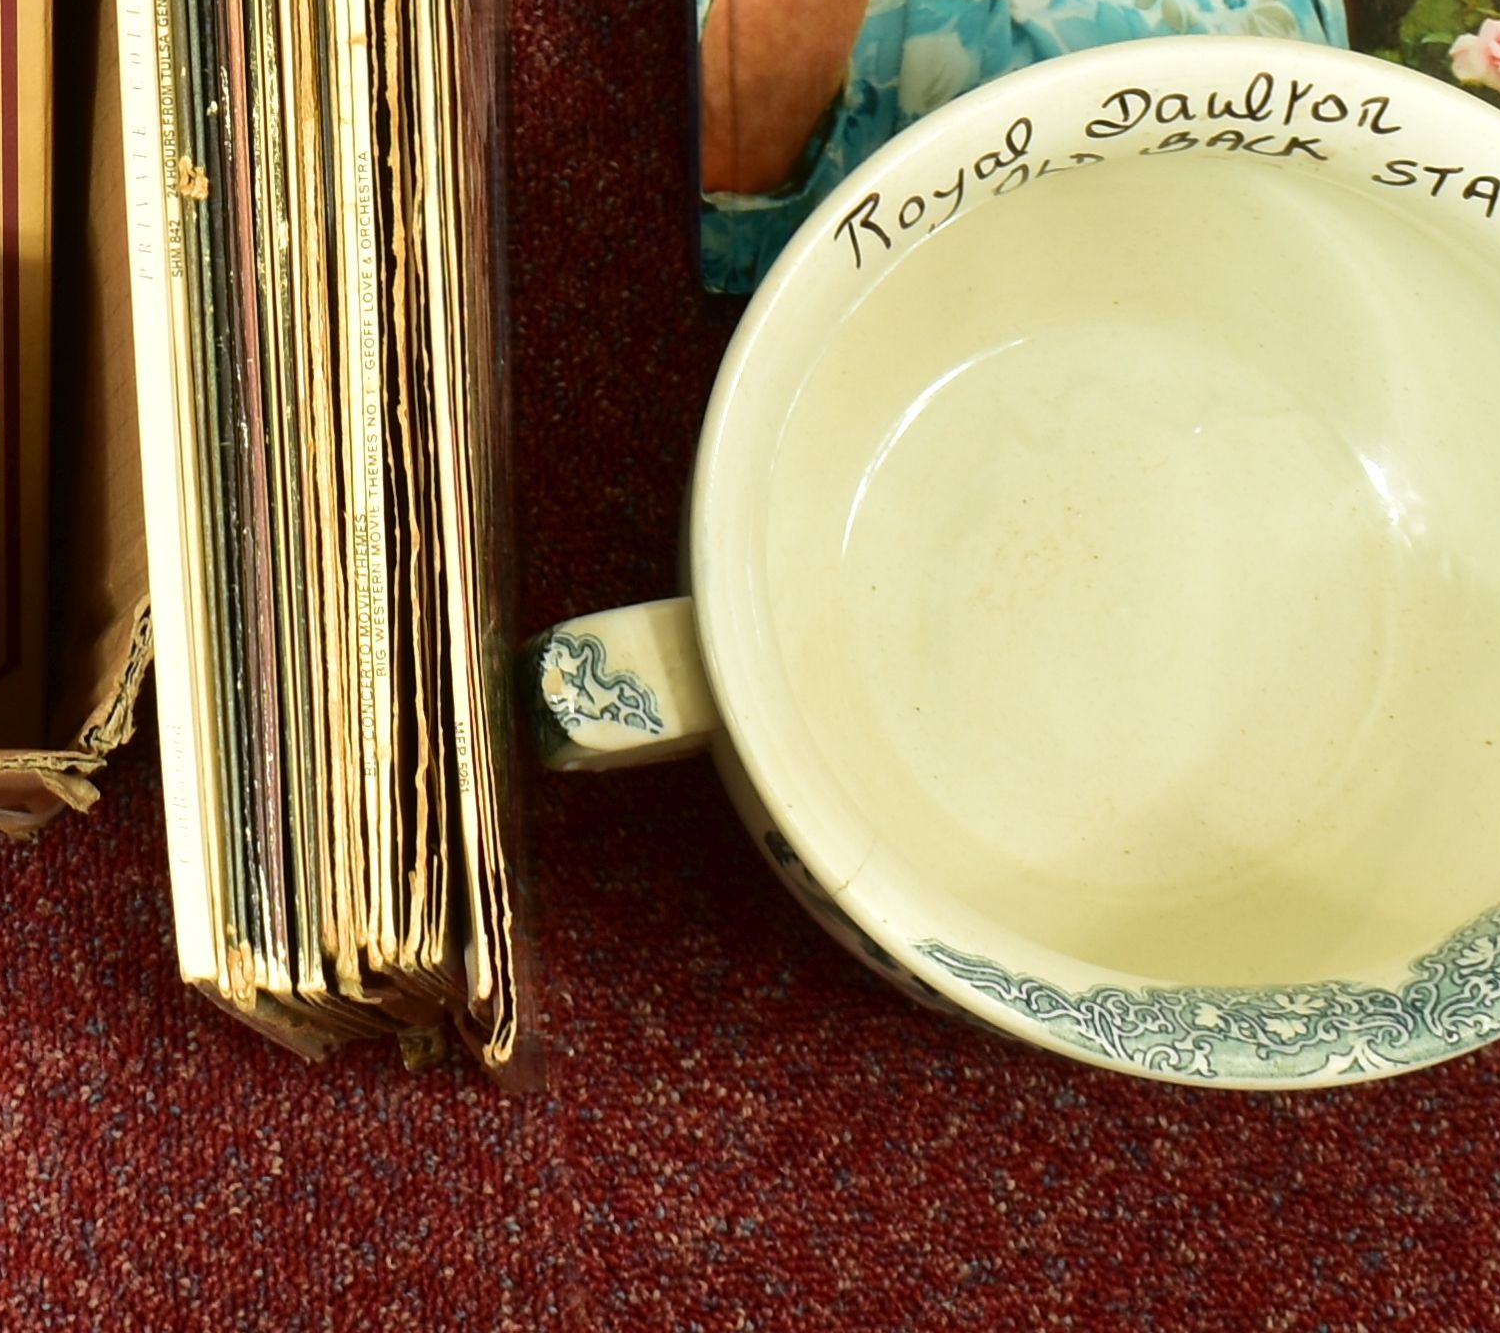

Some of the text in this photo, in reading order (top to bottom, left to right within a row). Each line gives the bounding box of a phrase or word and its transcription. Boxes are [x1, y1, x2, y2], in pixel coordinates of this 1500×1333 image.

[157, 33, 172, 81] TULSA
[160, 84, 175, 125] FROM
[162, 128, 178, 179] HOURS
[1139, 130, 1328, 161] BACK
[165, 181, 179, 198] 24
[355, 149, 372, 251] ORCHESTRA
[834, 116, 1033, 270] Royal
[168, 219, 182, 244] 842
[170, 246, 185, 278] SHM
[360, 269, 374, 313] LOVE
[362, 317, 377, 370] GEOFF
[365, 432, 380, 500] THEMES
[368, 504, 383, 557] MOVIE
[371, 561, 387, 640] WESTERN
